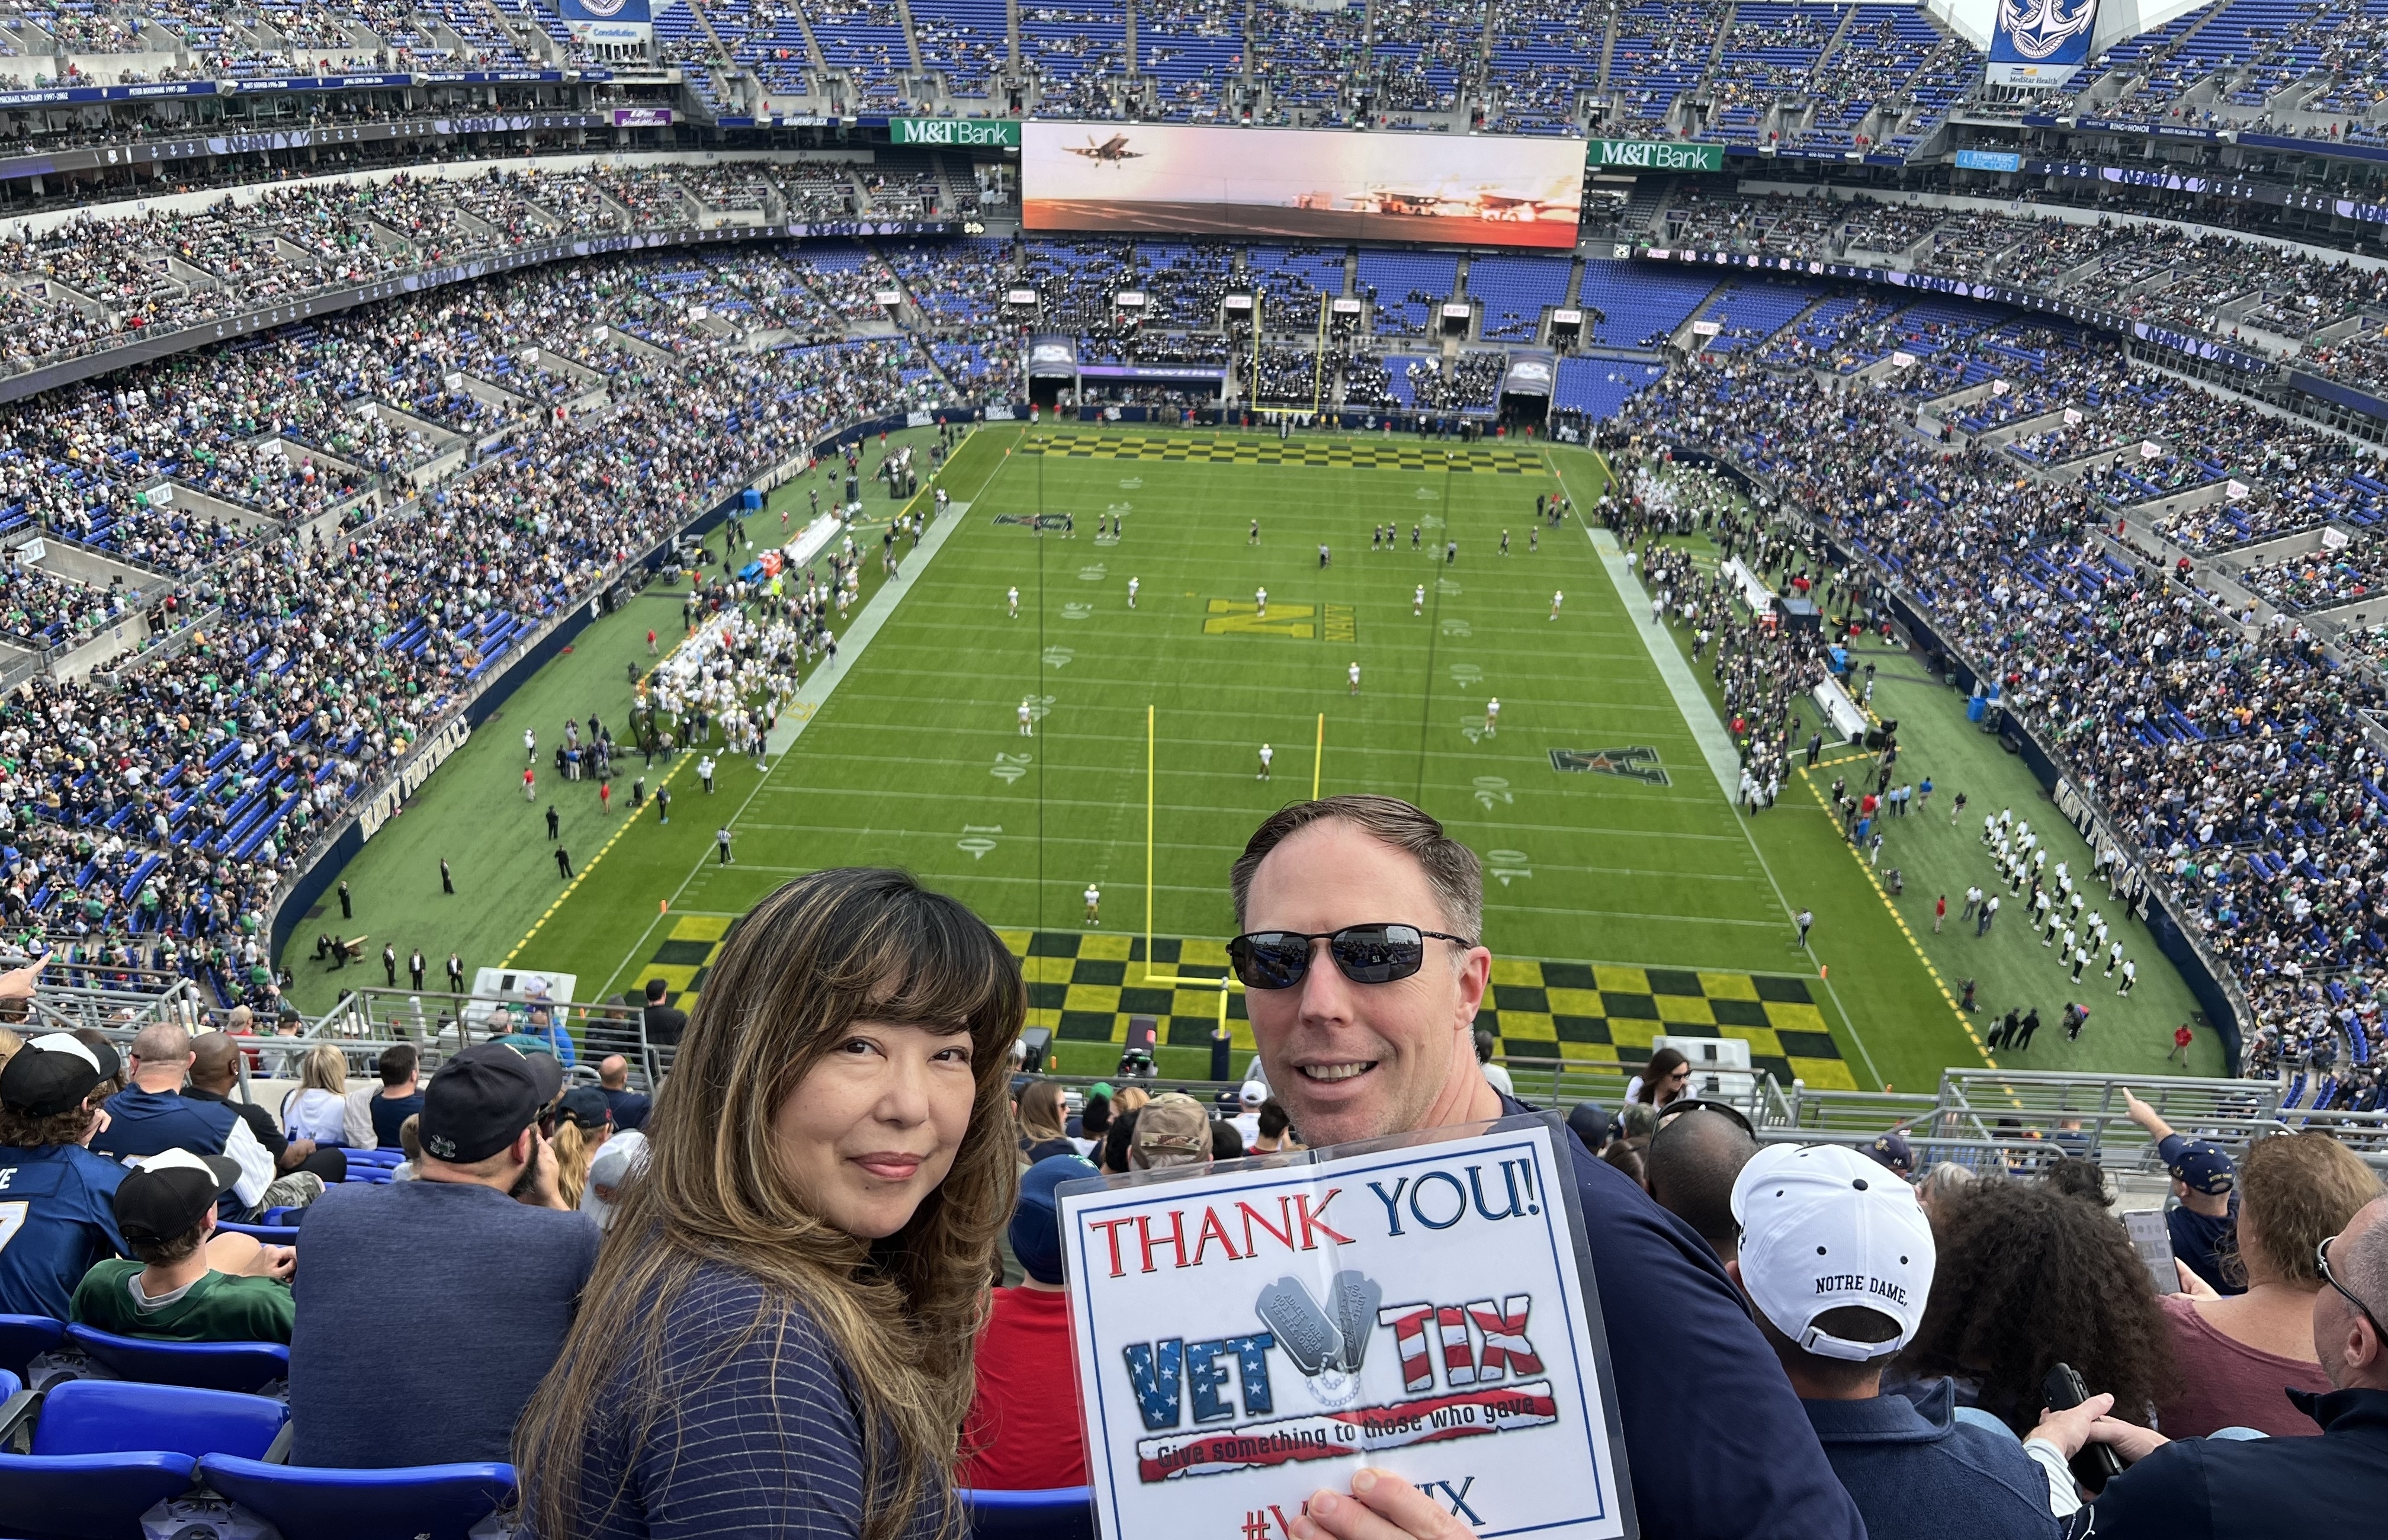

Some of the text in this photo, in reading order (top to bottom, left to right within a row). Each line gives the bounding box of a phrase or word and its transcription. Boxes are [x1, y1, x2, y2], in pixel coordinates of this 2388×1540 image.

[593, 28, 637, 37] Constellation
[782, 117, 828, 126] #RAVENSFLOCK
[903, 120, 1008, 145] M&T Bank
[2110, 122, 2125, 131] RING
[2127, 124, 2150, 133] HONOR
[1600, 142, 1709, 171] M&T Bank
[1970, 159, 2013, 170] FACTORY
[1972, 153, 2015, 162] STRATEGIC
[359, 714, 472, 843] NAVY FOOTBALL
[990, 752, 1033, 778] 20
[2053, 777, 2092, 836] NAVY
[957, 824, 1003, 852] 10
[1487, 850, 1533, 879] 10
[0, 1167, 18, 1189] E
[1089, 1158, 1540, 1278] THANK YOU!
[1815, 1275, 1864, 1294] NOTRE
[1270, 1301, 1315, 1355] VETTIX.ORG
[1283, 1293, 1324, 1341] ADMIT ONE
[1301, 1329, 1322, 1351] 2008
[1123, 1293, 1546, 1430] VET TIX
[1157, 1396, 1536, 1468] Give something to those who gave
